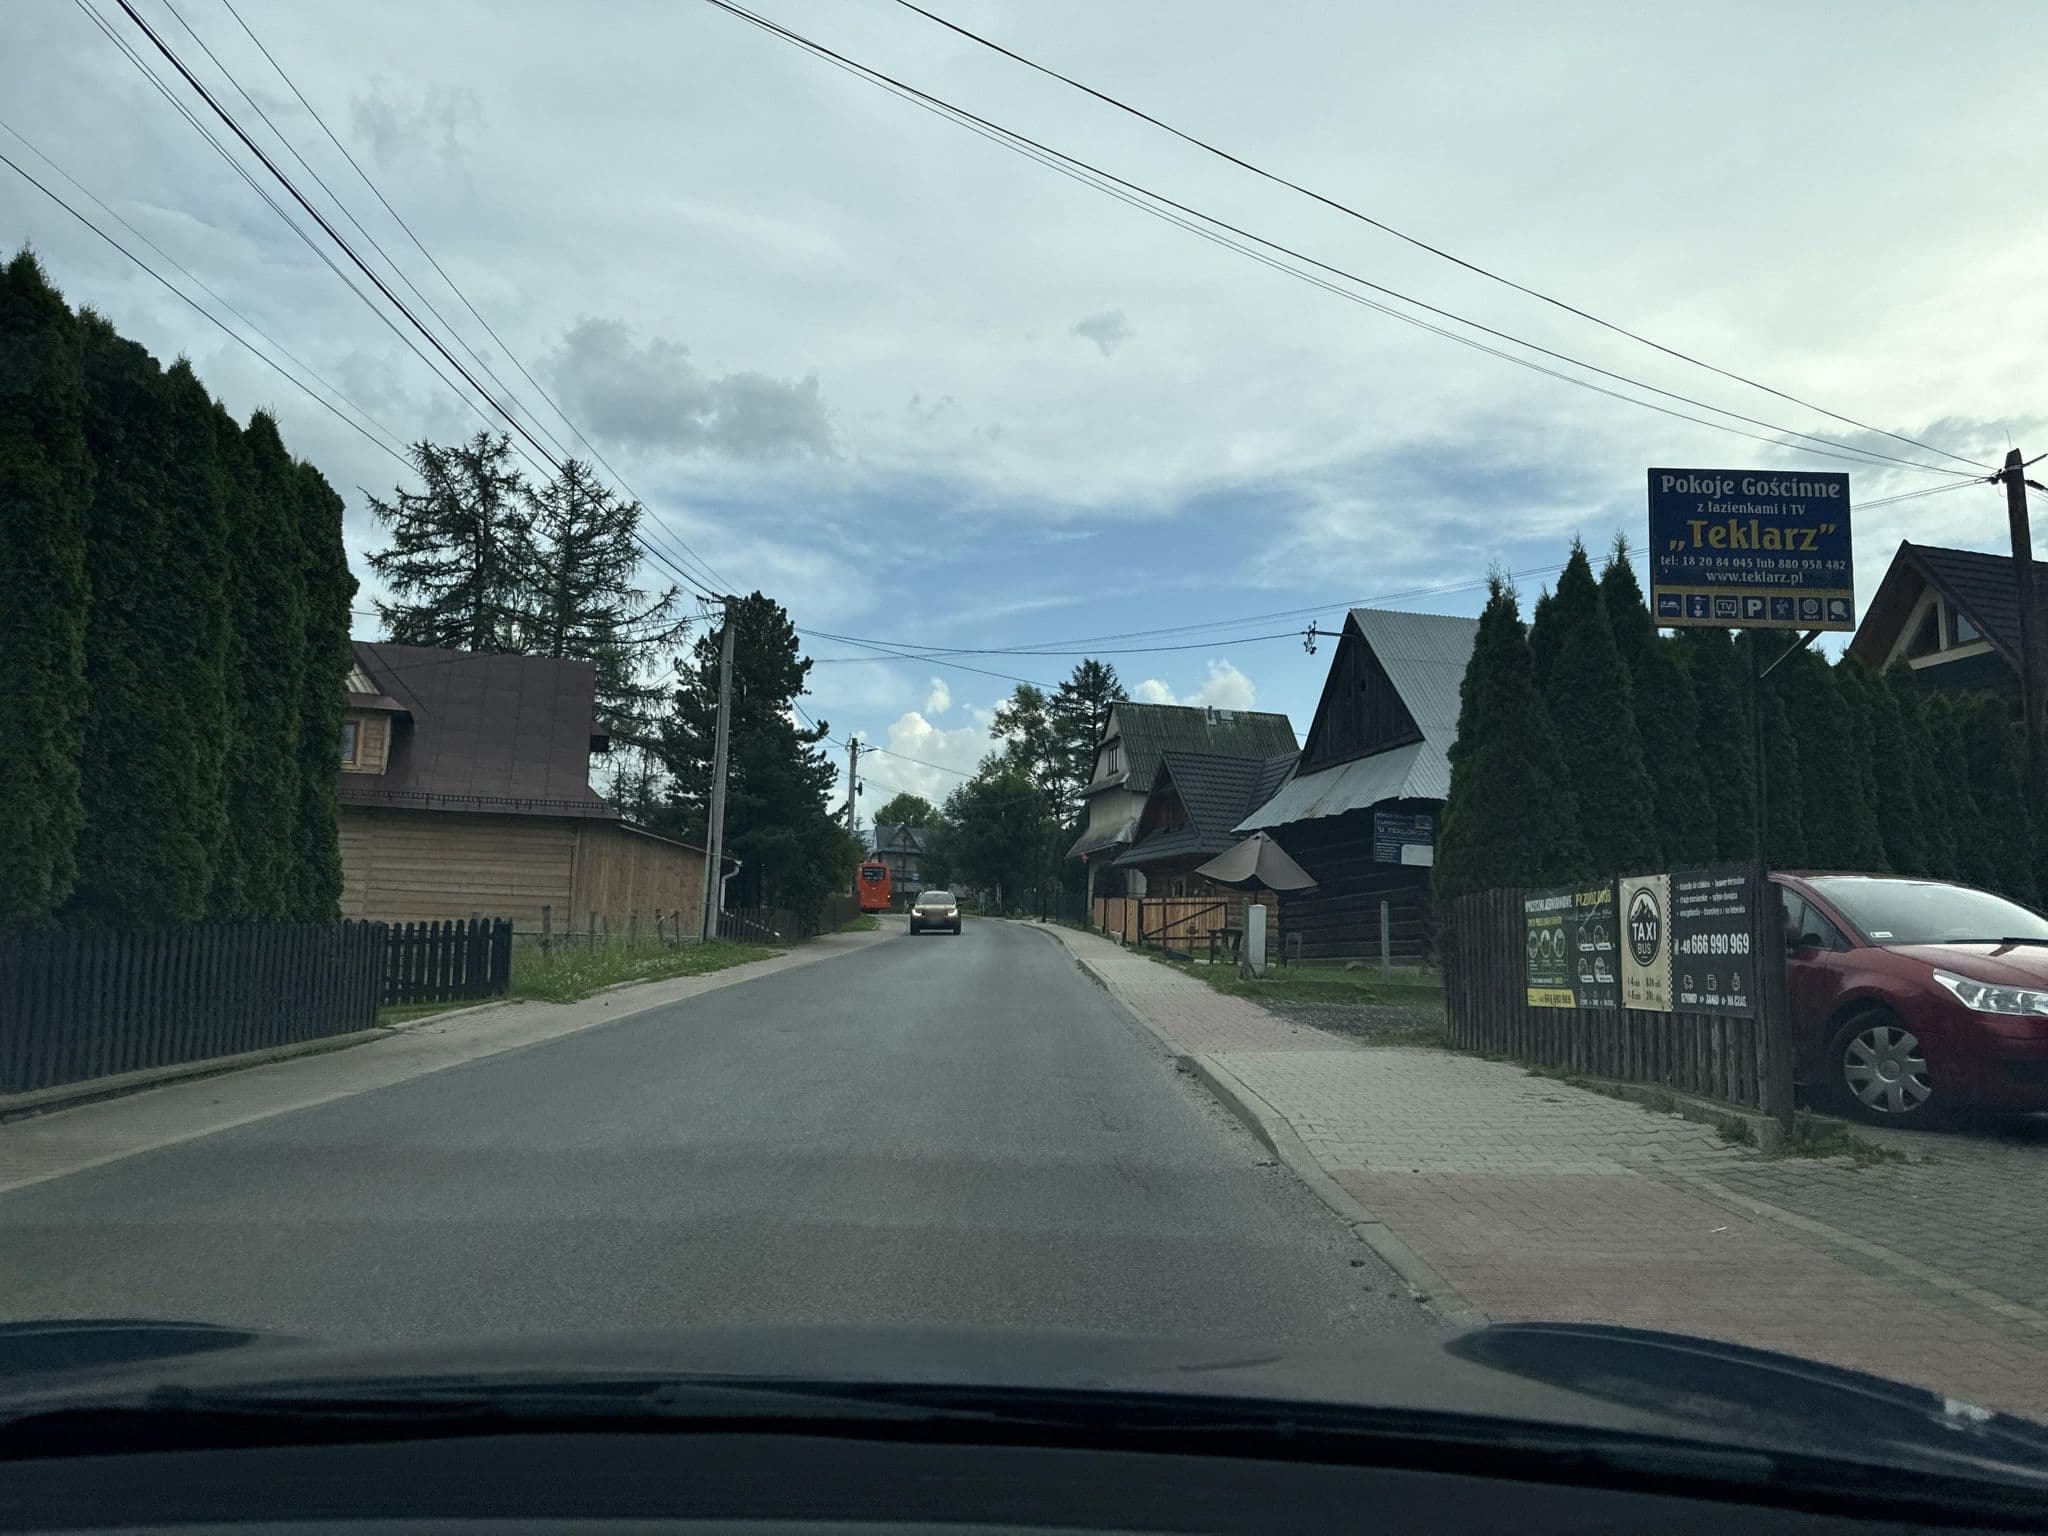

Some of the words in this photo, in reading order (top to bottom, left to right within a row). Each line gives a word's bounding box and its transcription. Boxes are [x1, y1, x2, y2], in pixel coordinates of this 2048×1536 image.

[1661, 474, 1735, 499] Pokoje
[1741, 477, 1841, 499] Gościnne
[1697, 503, 1705, 513] z
[1708, 501, 1779, 515] łazienkami
[1782, 504, 1787, 515] i
[1789, 504, 1806, 516] TV
[1660, 555, 1679, 567] tel:
[1682, 556, 1696, 567] 18
[1699, 556, 1713, 567] 20
[1716, 557, 1729, 567] 84
[1733, 558, 1753, 568] 045
[1756, 558, 1775, 569] lub
[1778, 559, 1798, 569] 880
[1802, 559, 1822, 570] 958
[1826, 560, 1846, 570] 482
[1705, 571, 1803, 586] www.teklarz.pl
[1632, 922, 1657, 941] TAXI
[1637, 943, 1652, 955] BUS
[1691, 934, 1709, 955] 666
[1710, 933, 1729, 955] 990
[1730, 932, 1750, 955] 969
